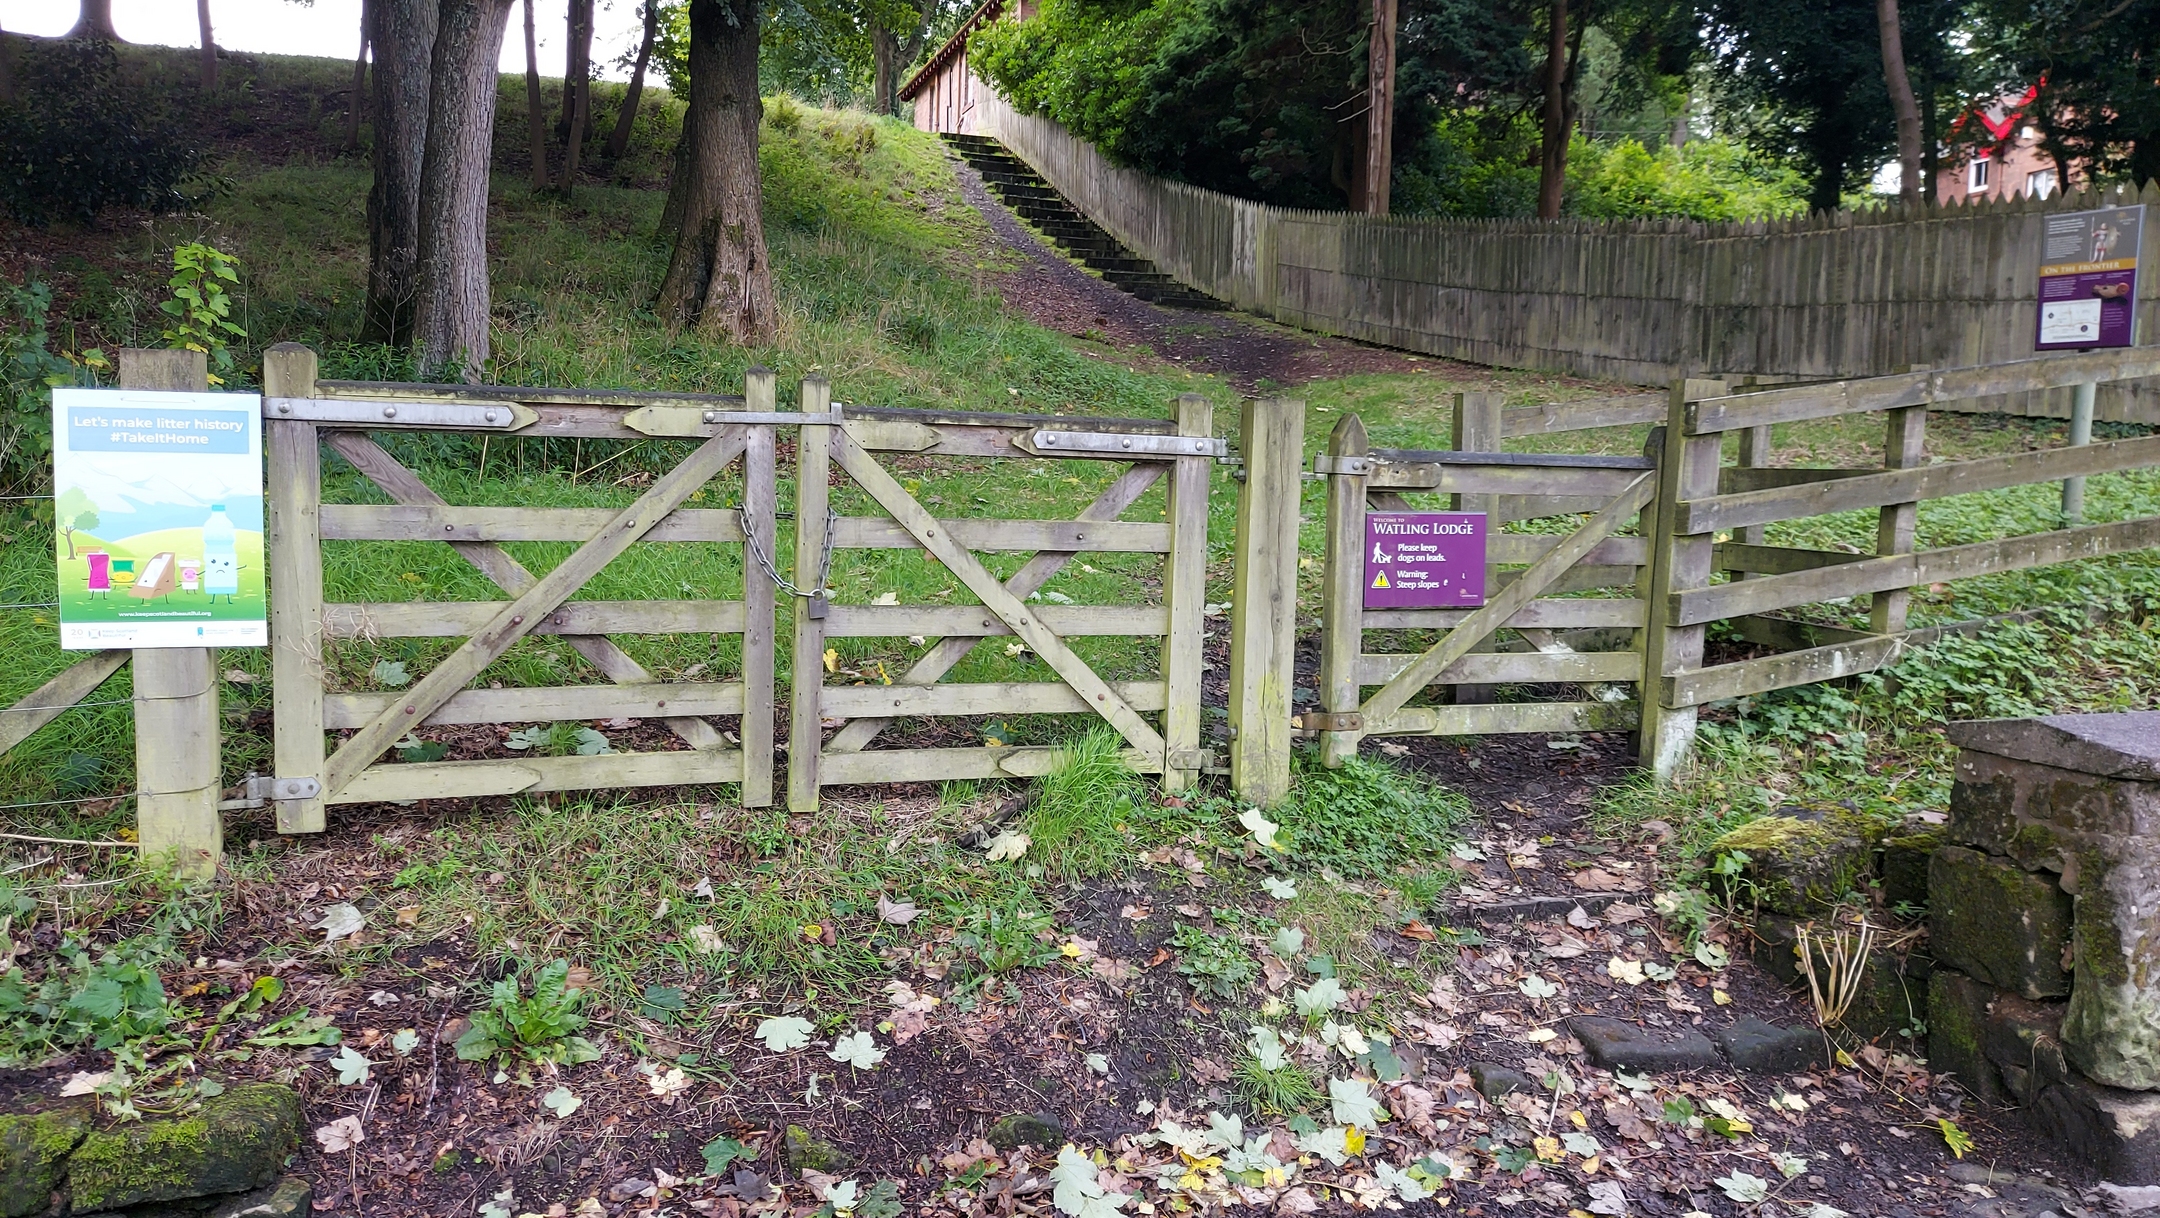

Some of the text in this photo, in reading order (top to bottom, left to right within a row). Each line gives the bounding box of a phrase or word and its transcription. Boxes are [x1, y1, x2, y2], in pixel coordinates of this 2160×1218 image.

[2061, 265, 2075, 273] THE
[2078, 261, 2120, 271] FRONTIER
[74, 416, 243, 433] Let's make litter history
[110, 431, 209, 445] #TakeItHome
[1373, 522, 1474, 535] WATLING LODGE
[1397, 543, 1437, 553] Please keep
[1397, 553, 1415, 563] dogs
[1426, 553, 1446, 562] leads.
[1396, 570, 1429, 579] Warning:
[1396, 580, 1439, 590] Steep slopes
